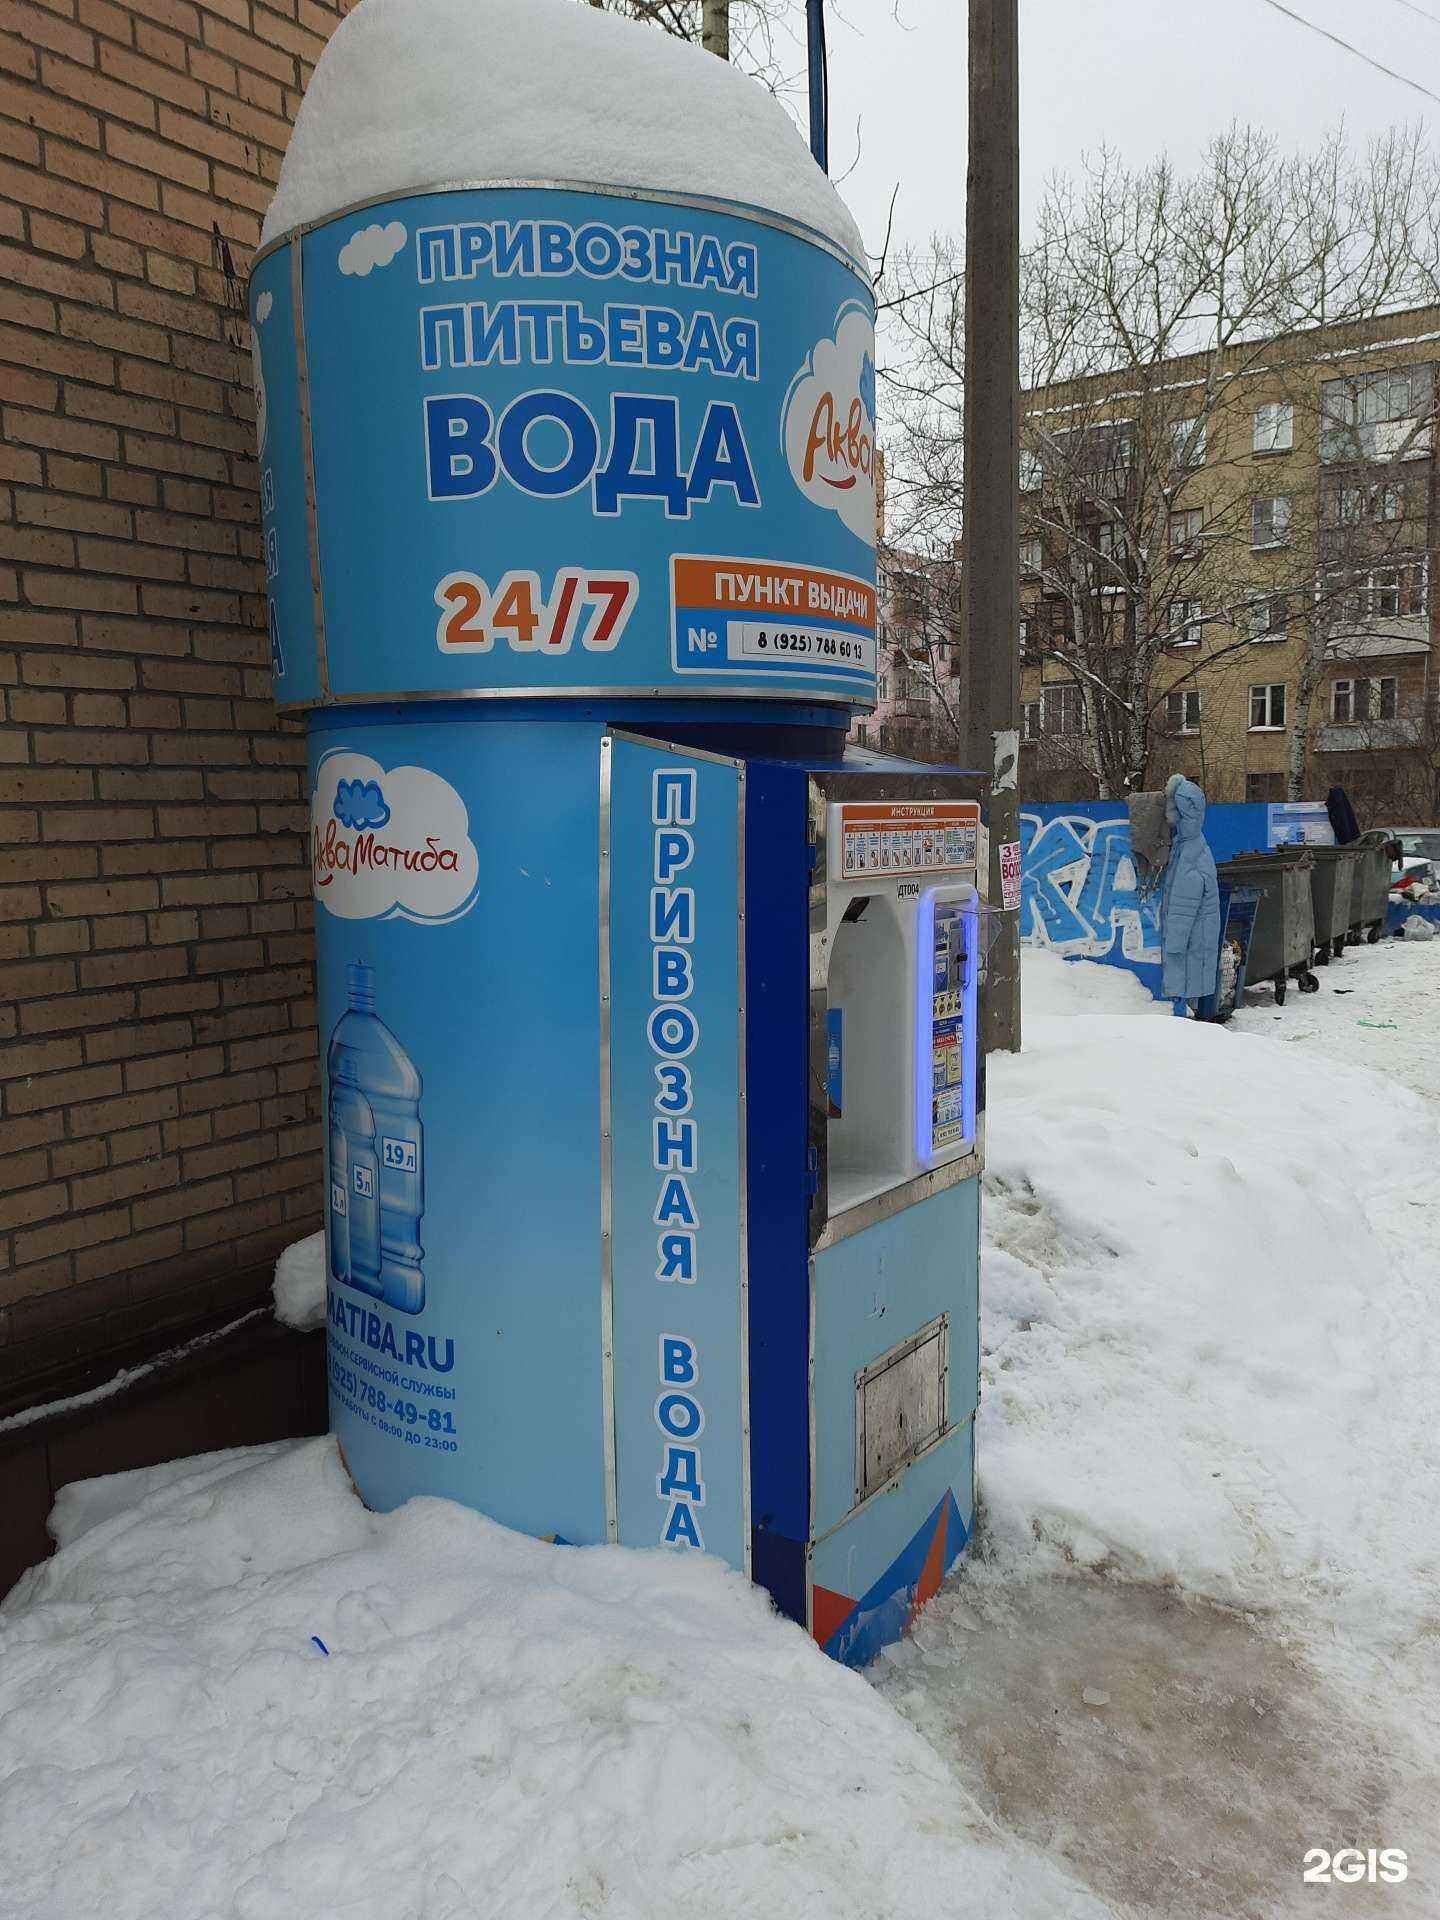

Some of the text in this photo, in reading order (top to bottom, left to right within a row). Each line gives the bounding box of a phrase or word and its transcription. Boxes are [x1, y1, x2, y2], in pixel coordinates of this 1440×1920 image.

[417, 221, 758, 298] ПРИВОЗНАЯ
[421, 302, 760, 380] ПИТЬЕВАЯ
[424, 389, 762, 519] ВОДА
[803, 392, 876, 487] Аква
[437, 568, 639, 653] 24/7
[715, 572, 868, 620] ПУНКТ ВЫДАЧИ
[757, 631, 768, 649] 8
[774, 633, 812, 653] (925)
[816, 637, 836, 656] 788
[840, 640, 851, 658] 60
[853, 643, 862, 660] 13
[891, 807, 935, 817] ИНСТРУКЦИЯ
[897, 883, 920, 899] ДТ004
[647, 767, 706, 1551] ПРИВОЗНАЯ ВОДА
[349, 1350, 456, 1400] СЕРВИСНОЙ СЛУЖБЫ
[359, 1379, 457, 1434] 788-49-81
[405, 1430, 421, 1445] ДО
[424, 1436, 458, 1452] 23:00
